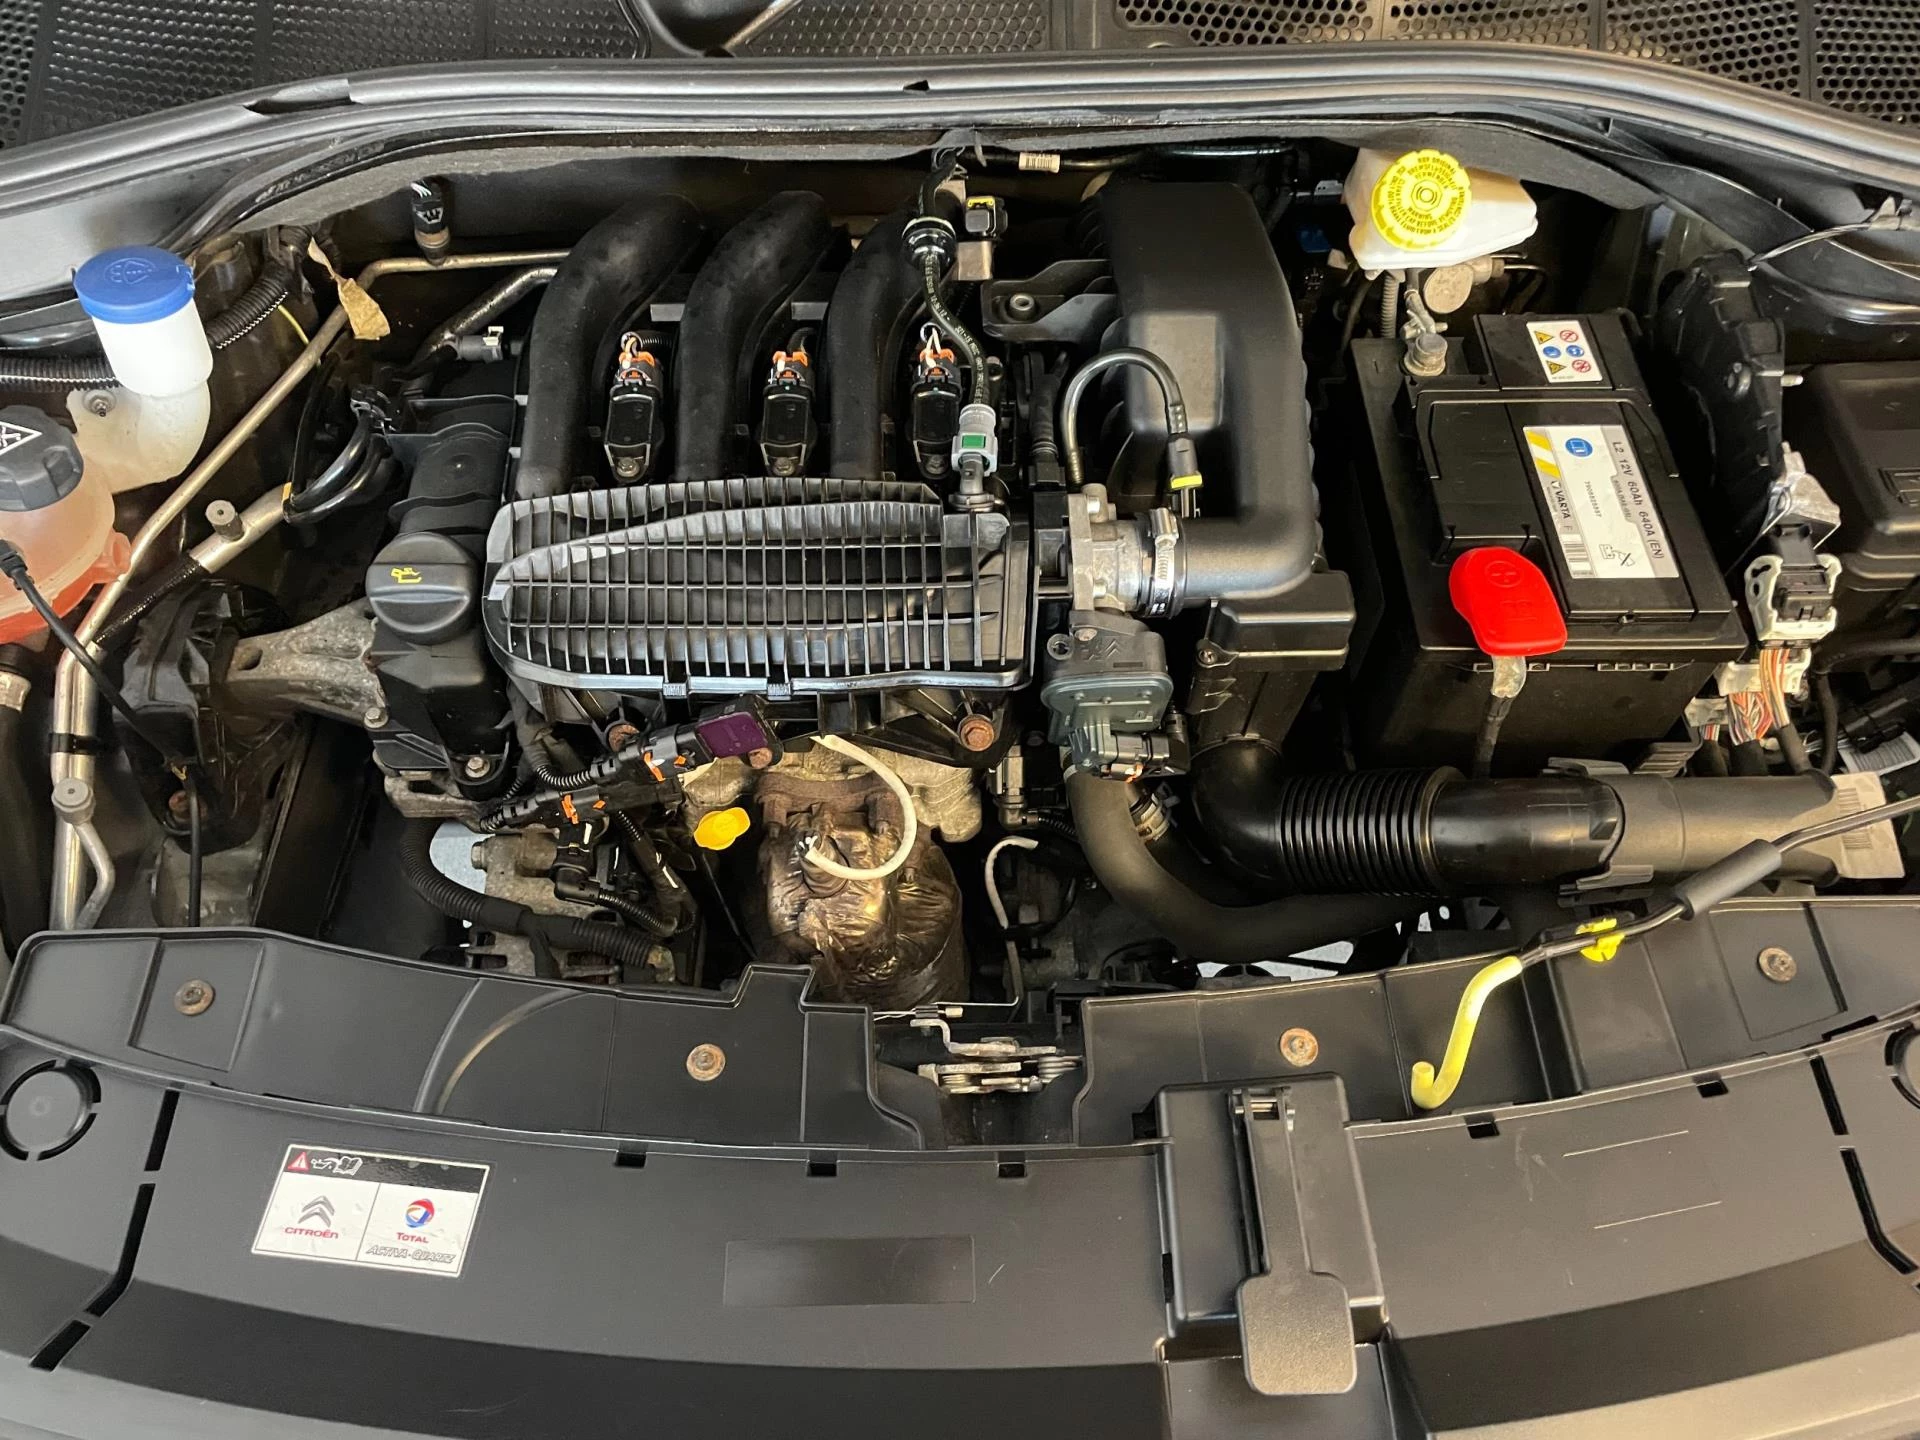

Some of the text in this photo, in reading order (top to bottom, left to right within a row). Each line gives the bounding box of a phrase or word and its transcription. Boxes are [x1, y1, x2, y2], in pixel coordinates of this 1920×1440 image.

[1553, 489, 1571, 519] VARTA
[1612, 441, 1665, 559] L2 12V 60Ah 640A (EN)
[396, 1231, 430, 1244] TOTAL
